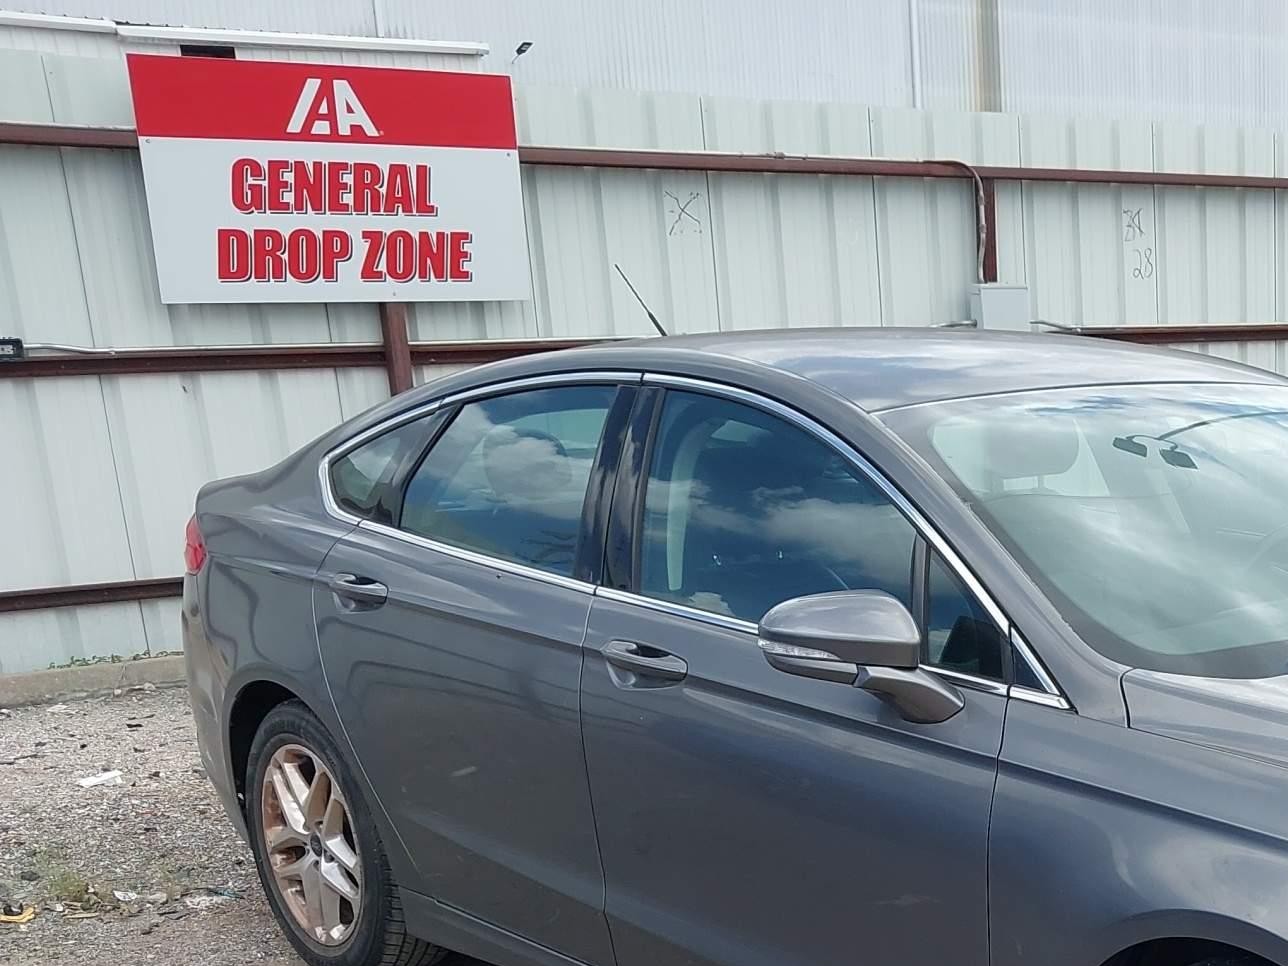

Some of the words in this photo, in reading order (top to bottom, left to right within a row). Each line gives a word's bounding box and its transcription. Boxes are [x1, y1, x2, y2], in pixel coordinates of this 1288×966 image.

[286, 78, 380, 136] IAA
[230, 158, 438, 216] GENERAL
[217, 228, 353, 283] DROP
[360, 229, 472, 283] ZONE
